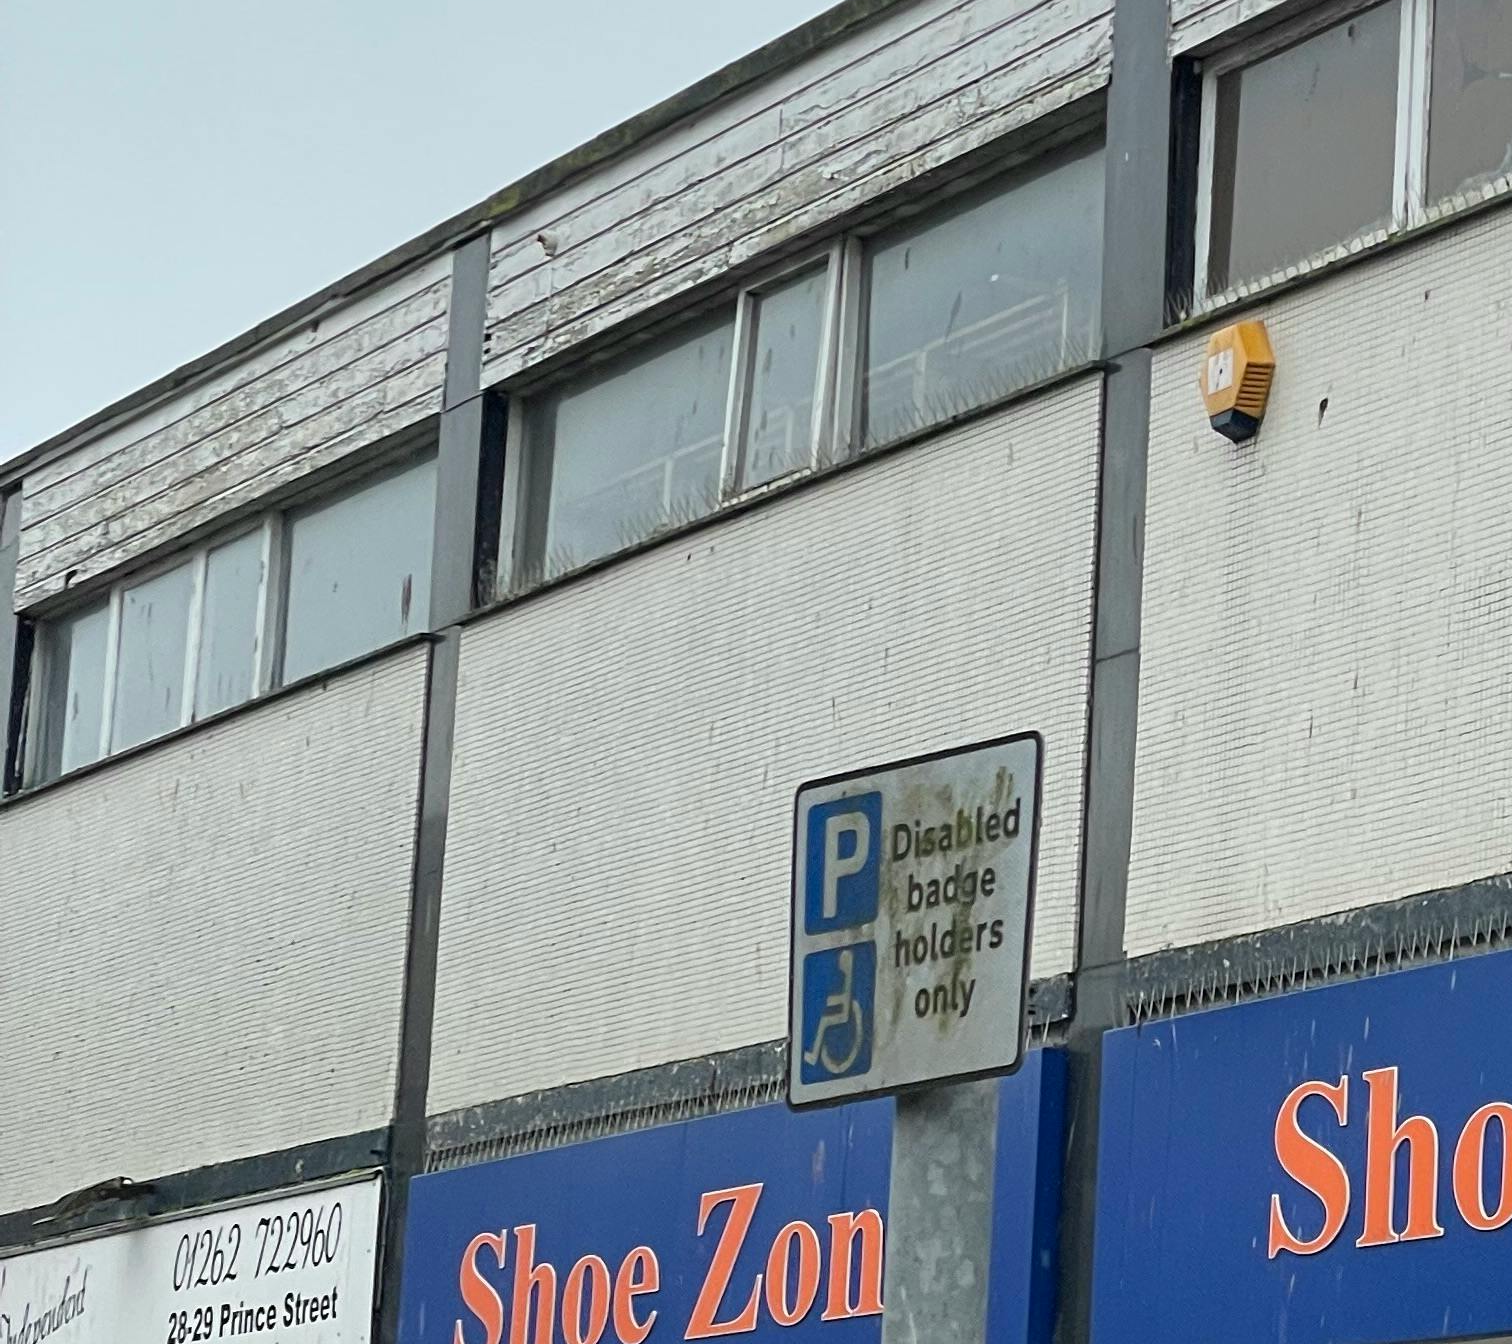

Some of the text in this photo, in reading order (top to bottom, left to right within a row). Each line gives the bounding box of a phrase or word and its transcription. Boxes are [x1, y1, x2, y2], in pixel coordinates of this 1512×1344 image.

[892, 798, 1021, 862] Disabled
[824, 812, 870, 918] P
[906, 863, 996, 913] badge
[894, 919, 1004, 968] holders
[914, 975, 976, 1018] only
[173, 1202, 343, 1291] 01262 722960
[684, 1182, 885, 1341] Zon
[219, 1301, 277, 1338] Prince
[283, 1286, 338, 1328] Street
